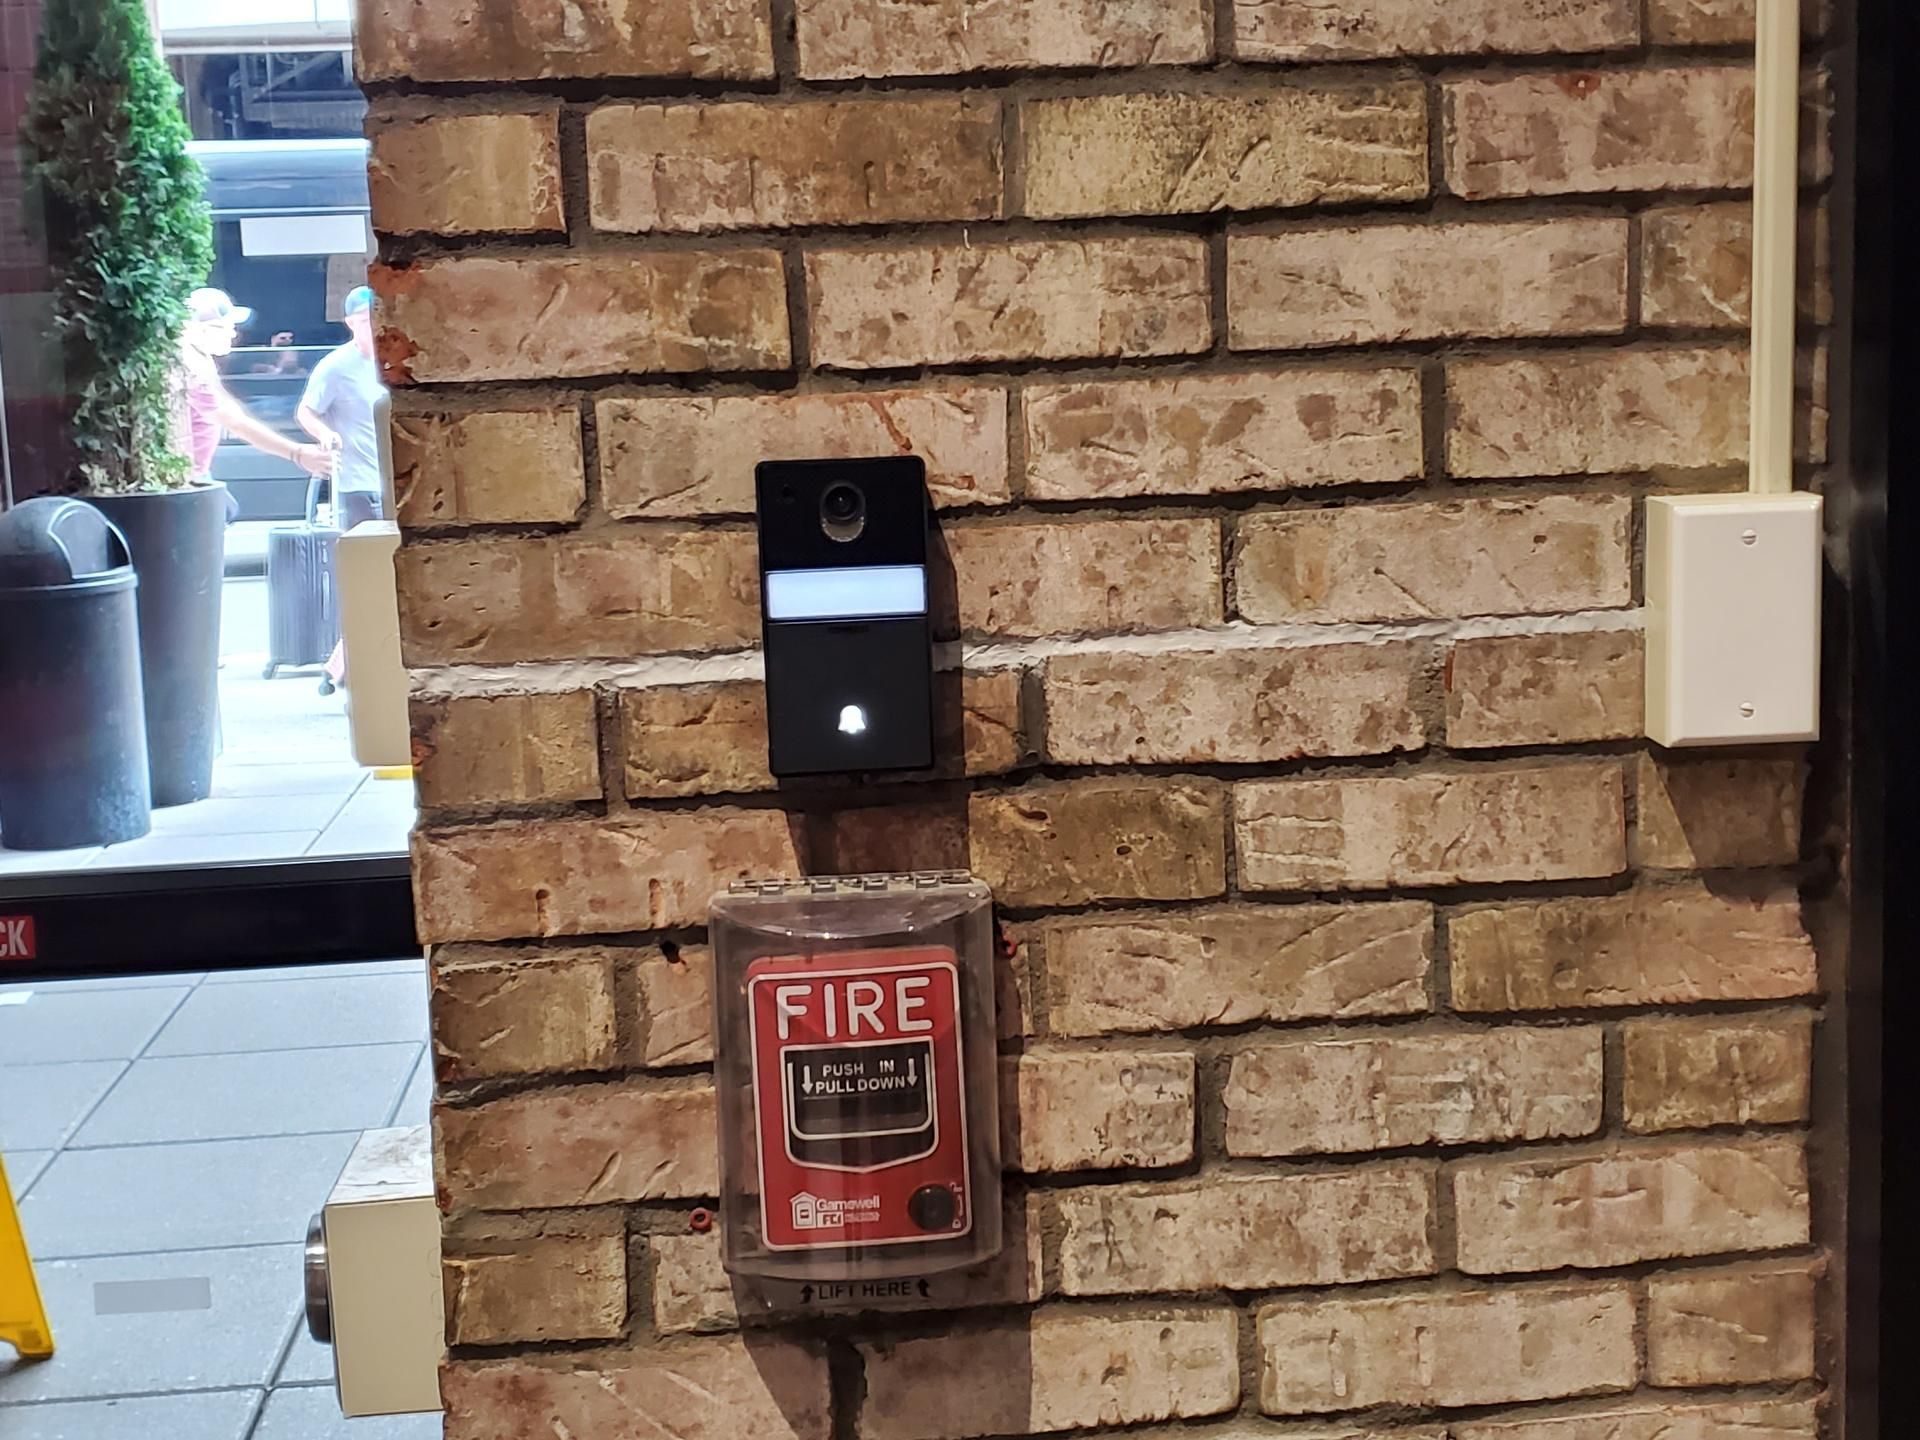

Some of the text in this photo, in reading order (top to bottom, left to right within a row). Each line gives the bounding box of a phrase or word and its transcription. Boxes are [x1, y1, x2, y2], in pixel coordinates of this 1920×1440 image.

[776, 976, 933, 1040] FIRE
[822, 1059, 895, 1077] PUSH IN
[815, 1075, 906, 1094] PULL DOWN
[818, 1281, 912, 1300] LIFT HERE
